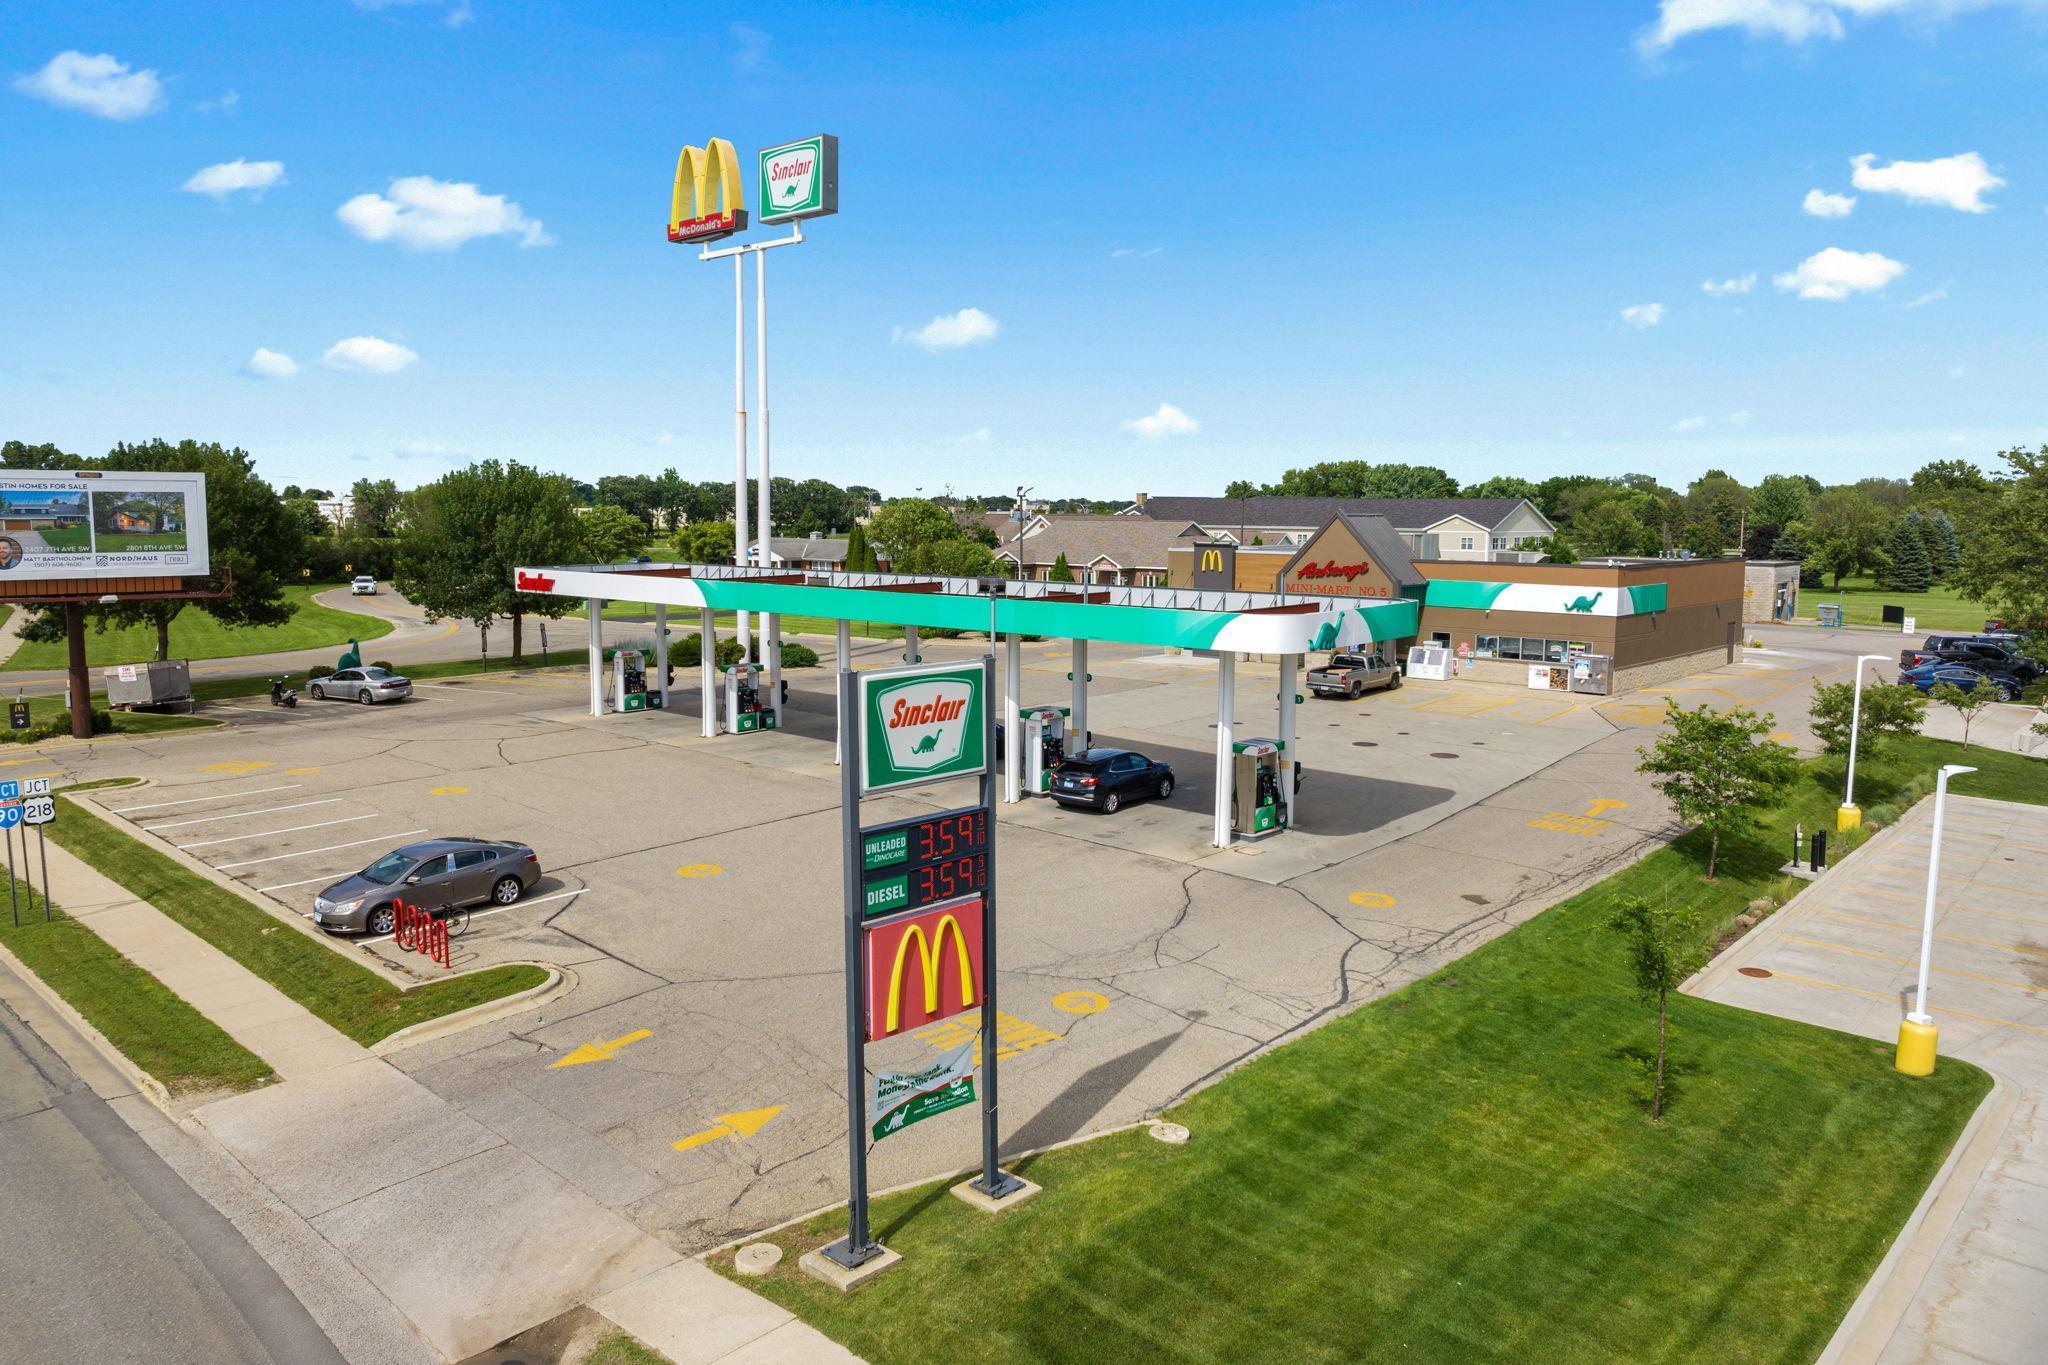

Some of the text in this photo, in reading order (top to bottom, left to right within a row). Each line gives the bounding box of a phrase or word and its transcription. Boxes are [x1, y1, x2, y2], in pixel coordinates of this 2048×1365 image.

[771, 158, 812, 181] Sinclair
[679, 219, 721, 236] McDonald's
[1286, 583, 1387, 596] MINI-MART NO. 5
[889, 695, 966, 729] Sinclair
[26, 779, 48, 793] JCT
[27, 803, 52, 818] 218
[865, 837, 906, 855] UNLEADED
[920, 815, 973, 859] 3.59
[920, 857, 973, 903] 3.59
[867, 884, 906, 906] DIESEL
